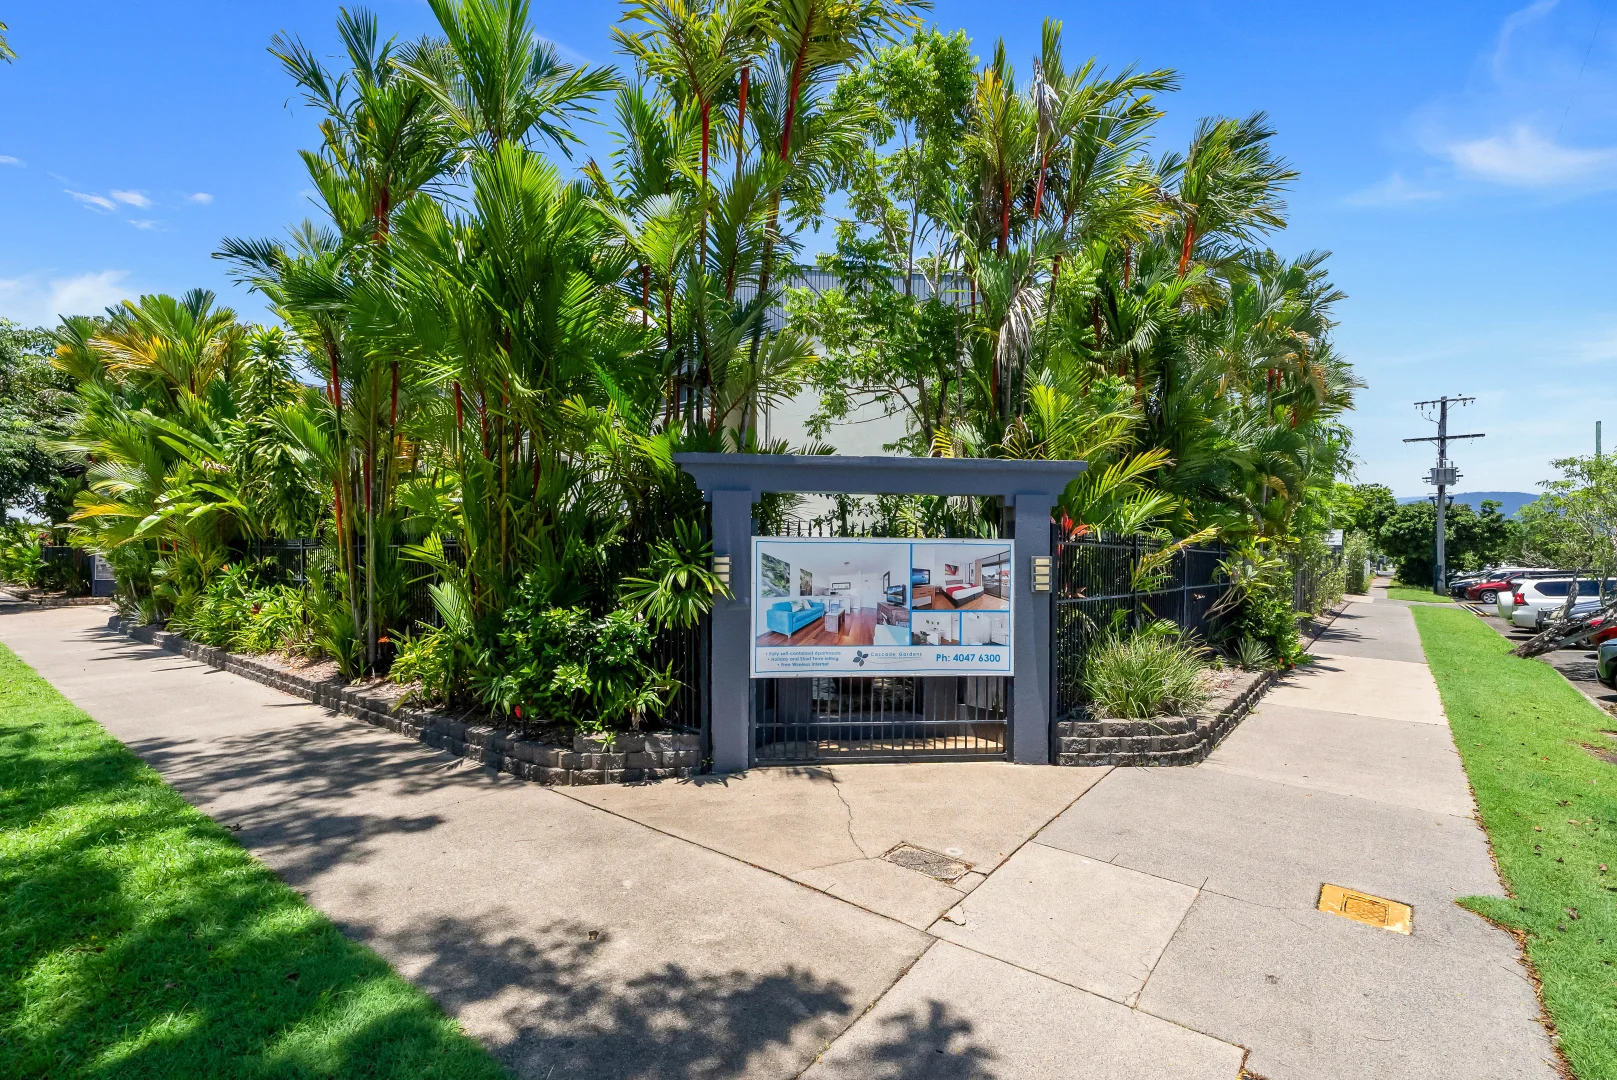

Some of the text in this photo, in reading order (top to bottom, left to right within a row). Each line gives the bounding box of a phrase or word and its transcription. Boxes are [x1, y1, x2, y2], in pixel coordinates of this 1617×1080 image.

[936, 654, 1000, 662] Ph: 4047 6300
